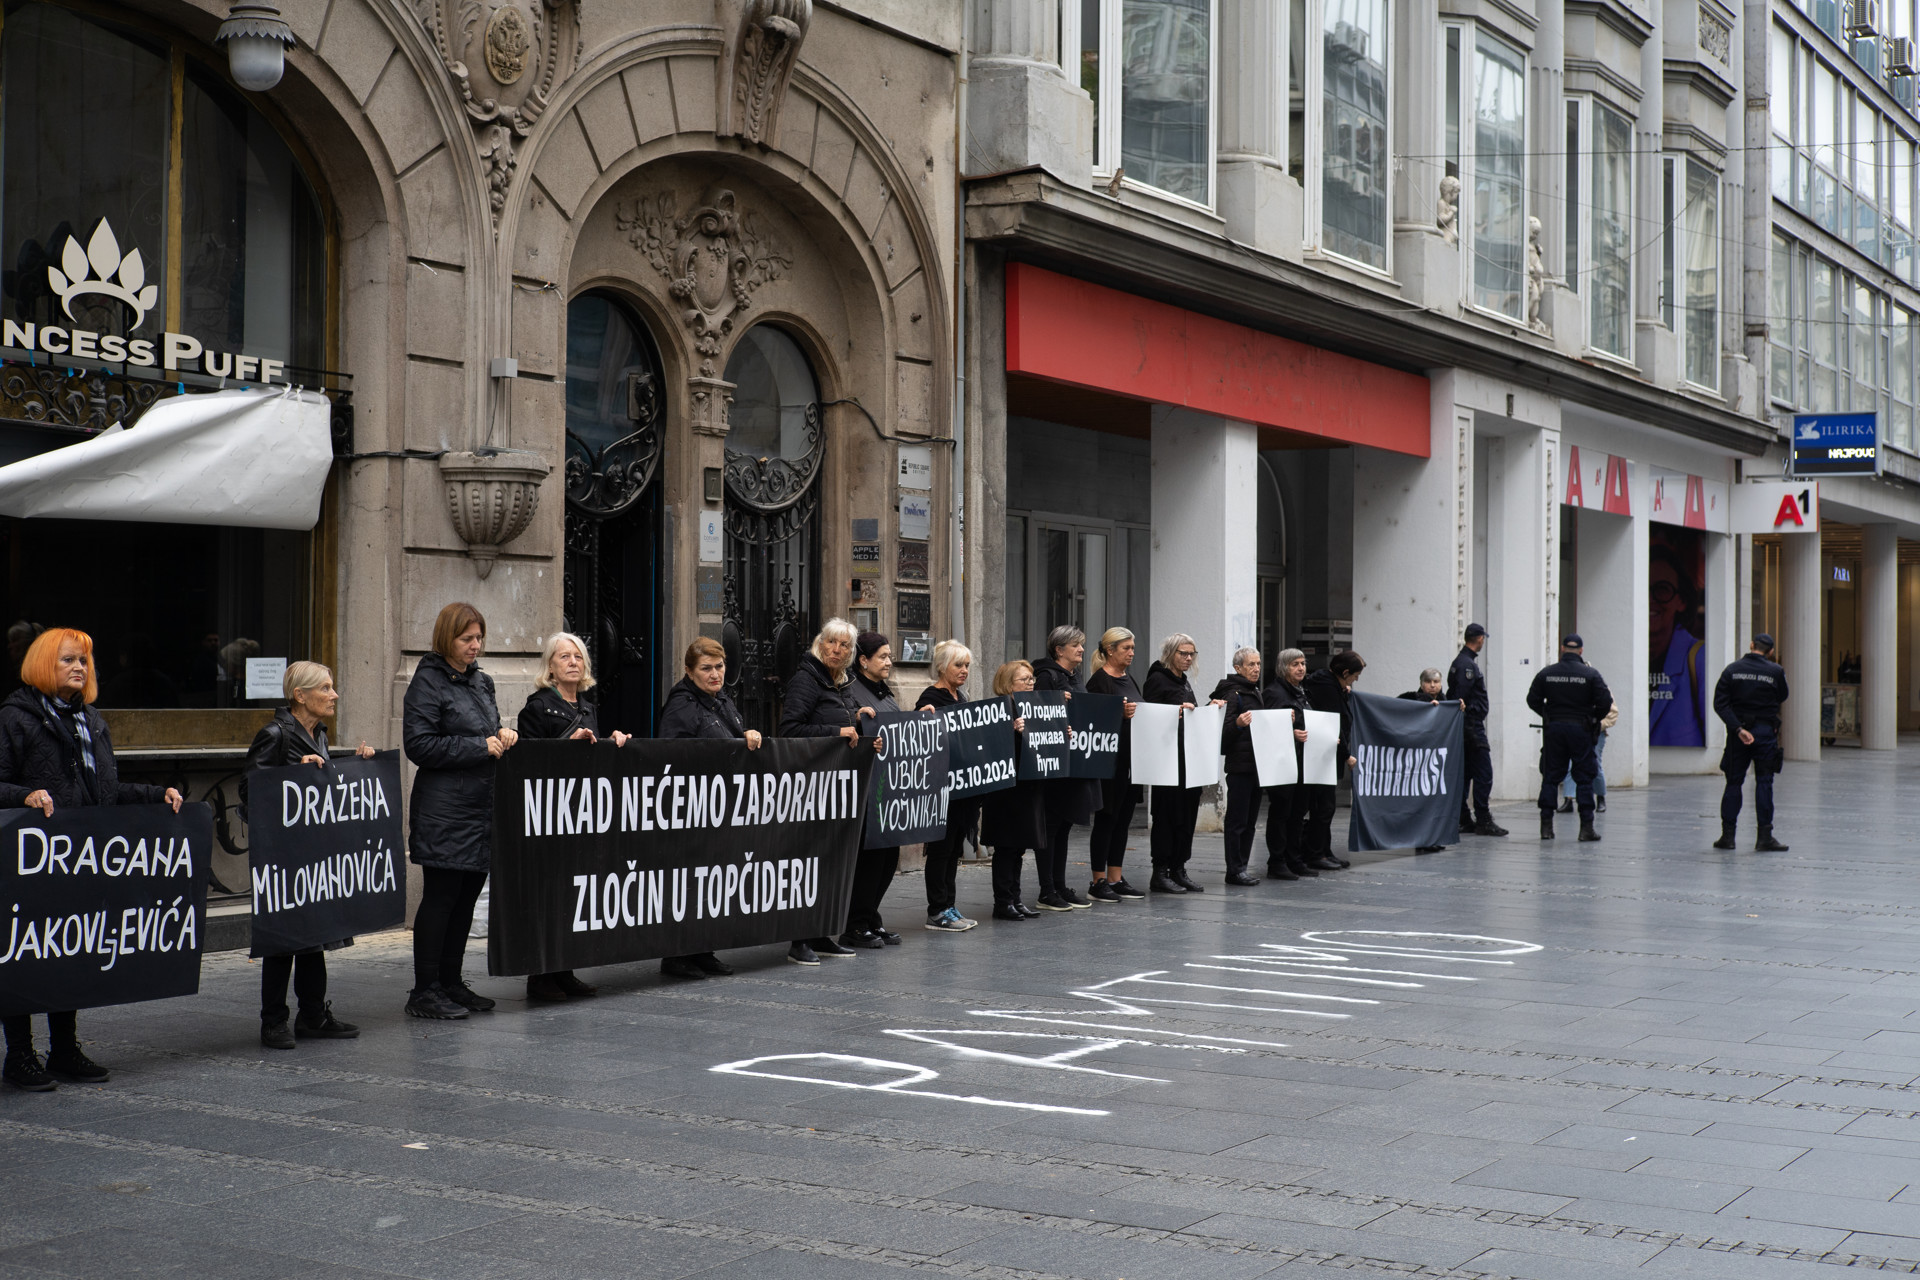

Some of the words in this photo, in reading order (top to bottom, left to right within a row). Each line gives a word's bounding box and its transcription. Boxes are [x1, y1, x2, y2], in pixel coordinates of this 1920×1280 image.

[164, 331, 285, 384] PUFF
[1822, 425, 1874, 436] ILIRIKA
[1774, 489, 1809, 526] A1
[1833, 566, 1851, 582] ZARA
[1018, 701, 1032, 719] 20
[1033, 704, 1067, 721] година
[877, 713, 943, 761] OTKRIJTE
[1029, 730, 1065, 750] држава
[1069, 722, 1119, 759] војска
[888, 755, 931, 790] UBICE
[1036, 753, 1059, 776] ћути
[1358, 744, 1447, 796] SOLIDARNOST
[282, 774, 390, 828] DRAŽENA
[524, 776, 613, 836] NIKAD
[621, 764, 726, 832] NEĆEMO
[731, 769, 858, 827] ZABORAVITI
[17, 827, 192, 879] DRAGANA
[573, 860, 663, 932] ZLOČIN
[672, 868, 687, 922] U
[694, 852, 819, 919] TOPČIDERU
